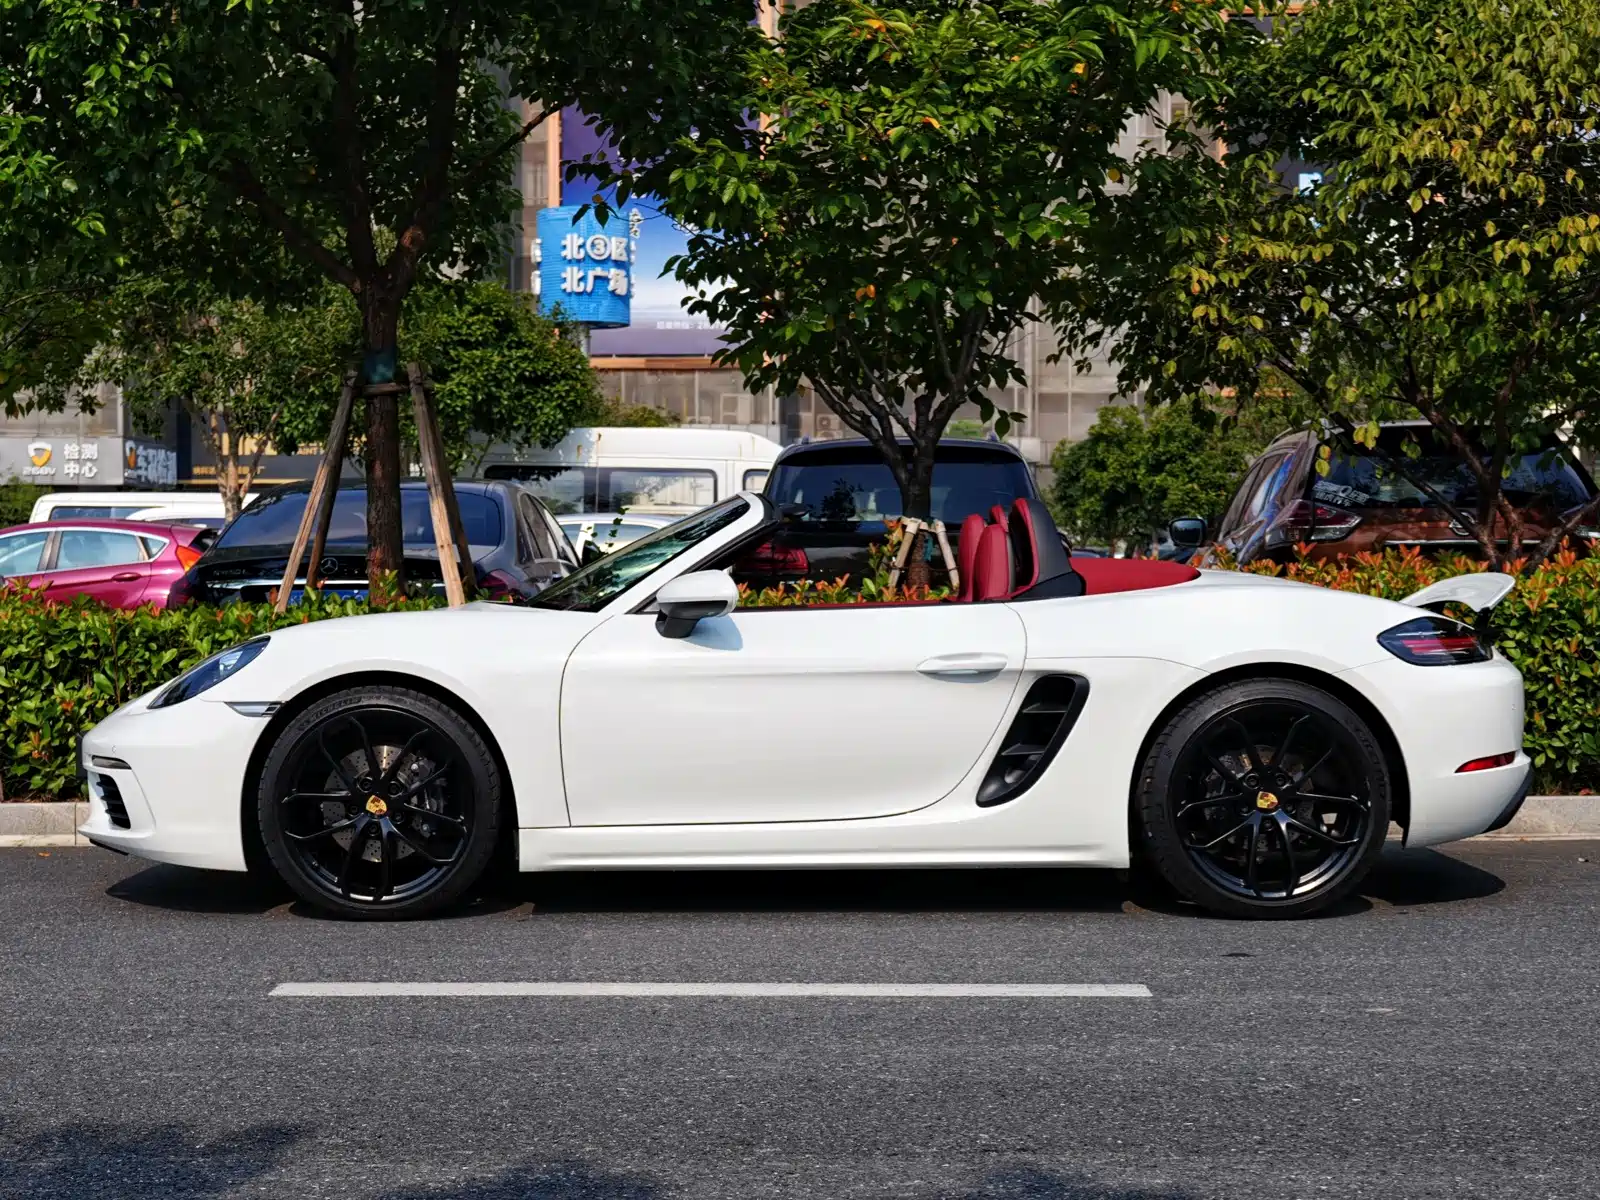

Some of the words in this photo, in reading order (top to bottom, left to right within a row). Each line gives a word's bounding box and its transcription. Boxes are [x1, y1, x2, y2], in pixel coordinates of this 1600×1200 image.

[561, 266, 628, 295] 北广场
[64, 443, 98, 460] 检测
[64, 460, 98, 479] 中心
